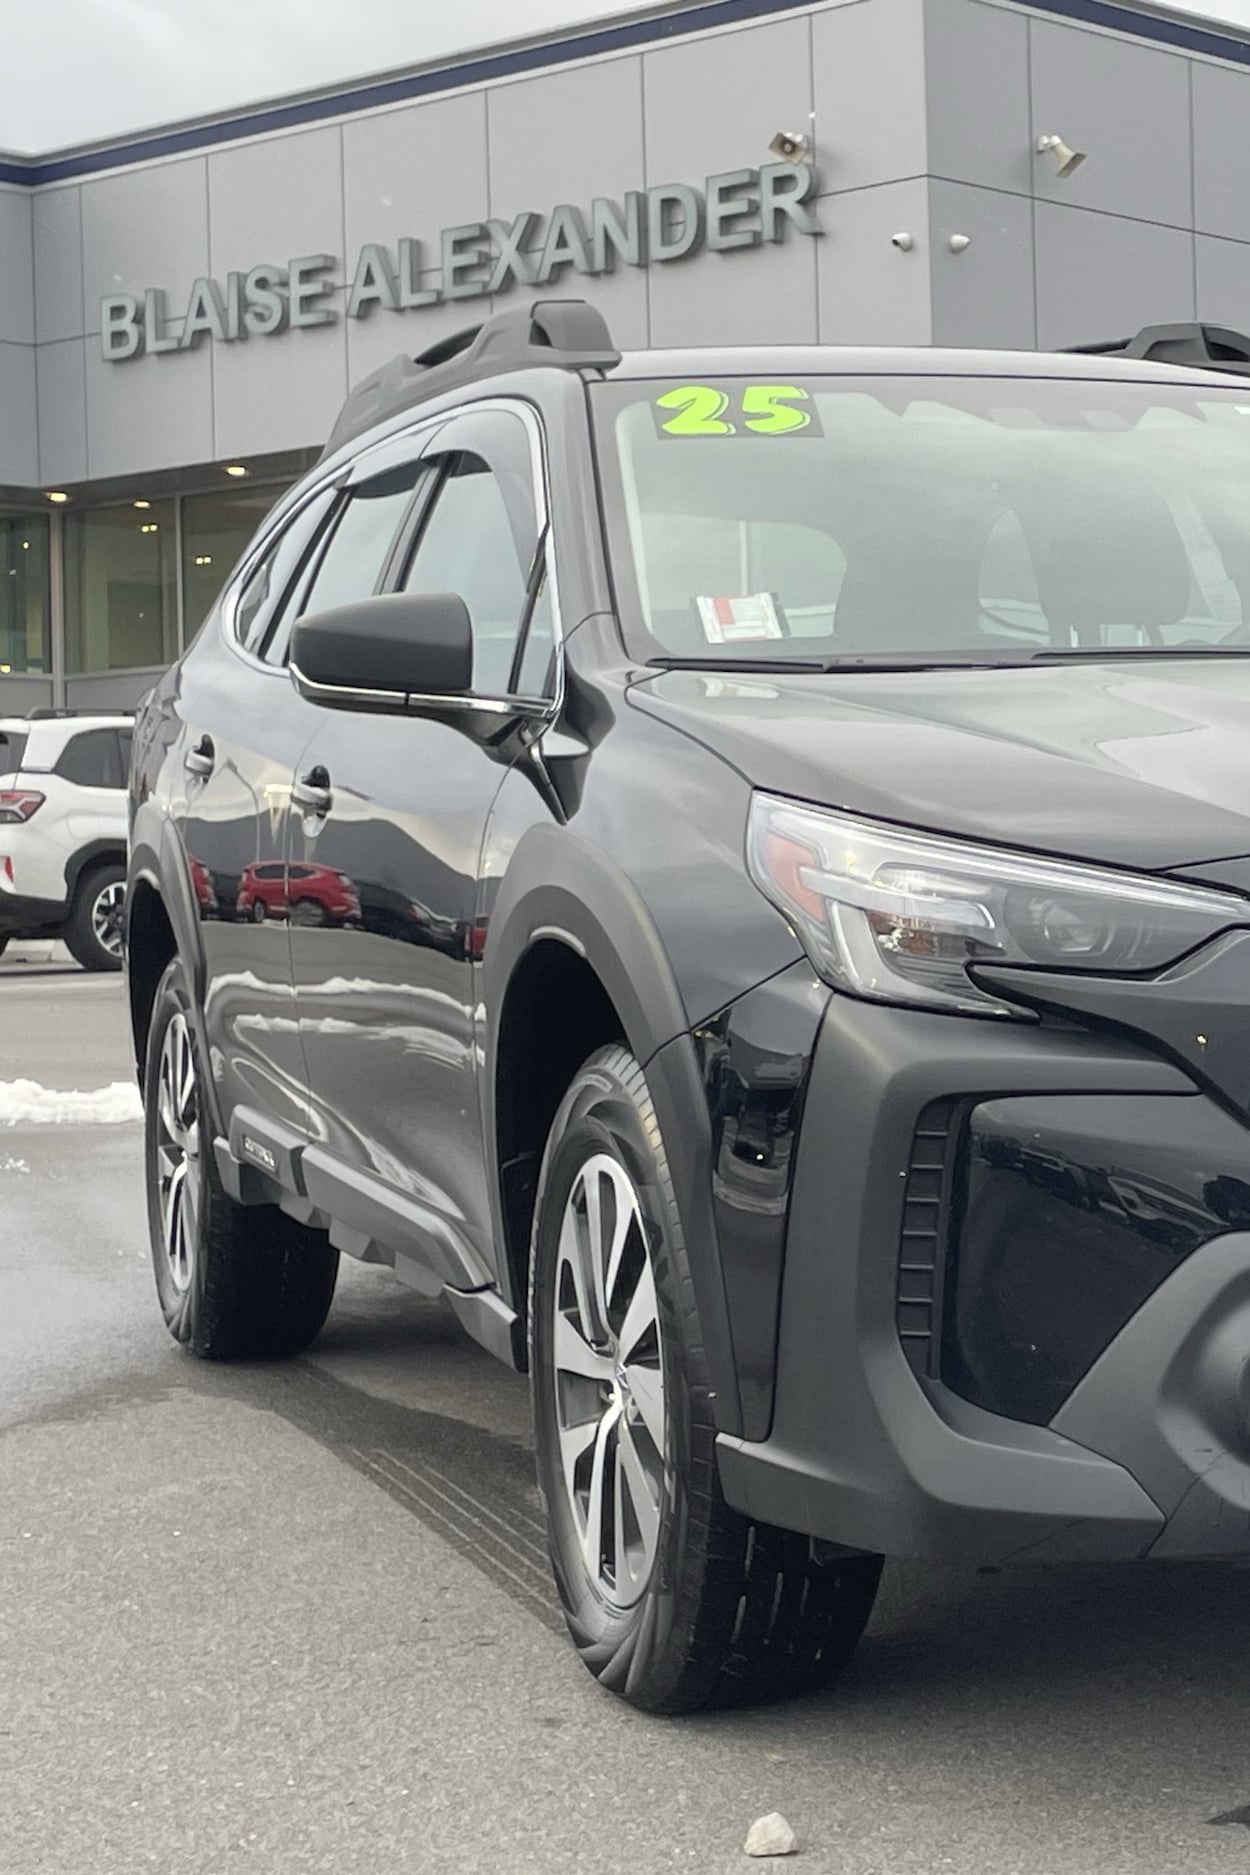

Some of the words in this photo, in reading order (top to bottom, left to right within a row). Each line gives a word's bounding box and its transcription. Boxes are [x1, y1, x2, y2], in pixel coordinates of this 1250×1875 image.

[100, 253, 338, 362] BLAISE
[347, 161, 824, 318] ALEXANDER
[655, 384, 811, 435] 25
